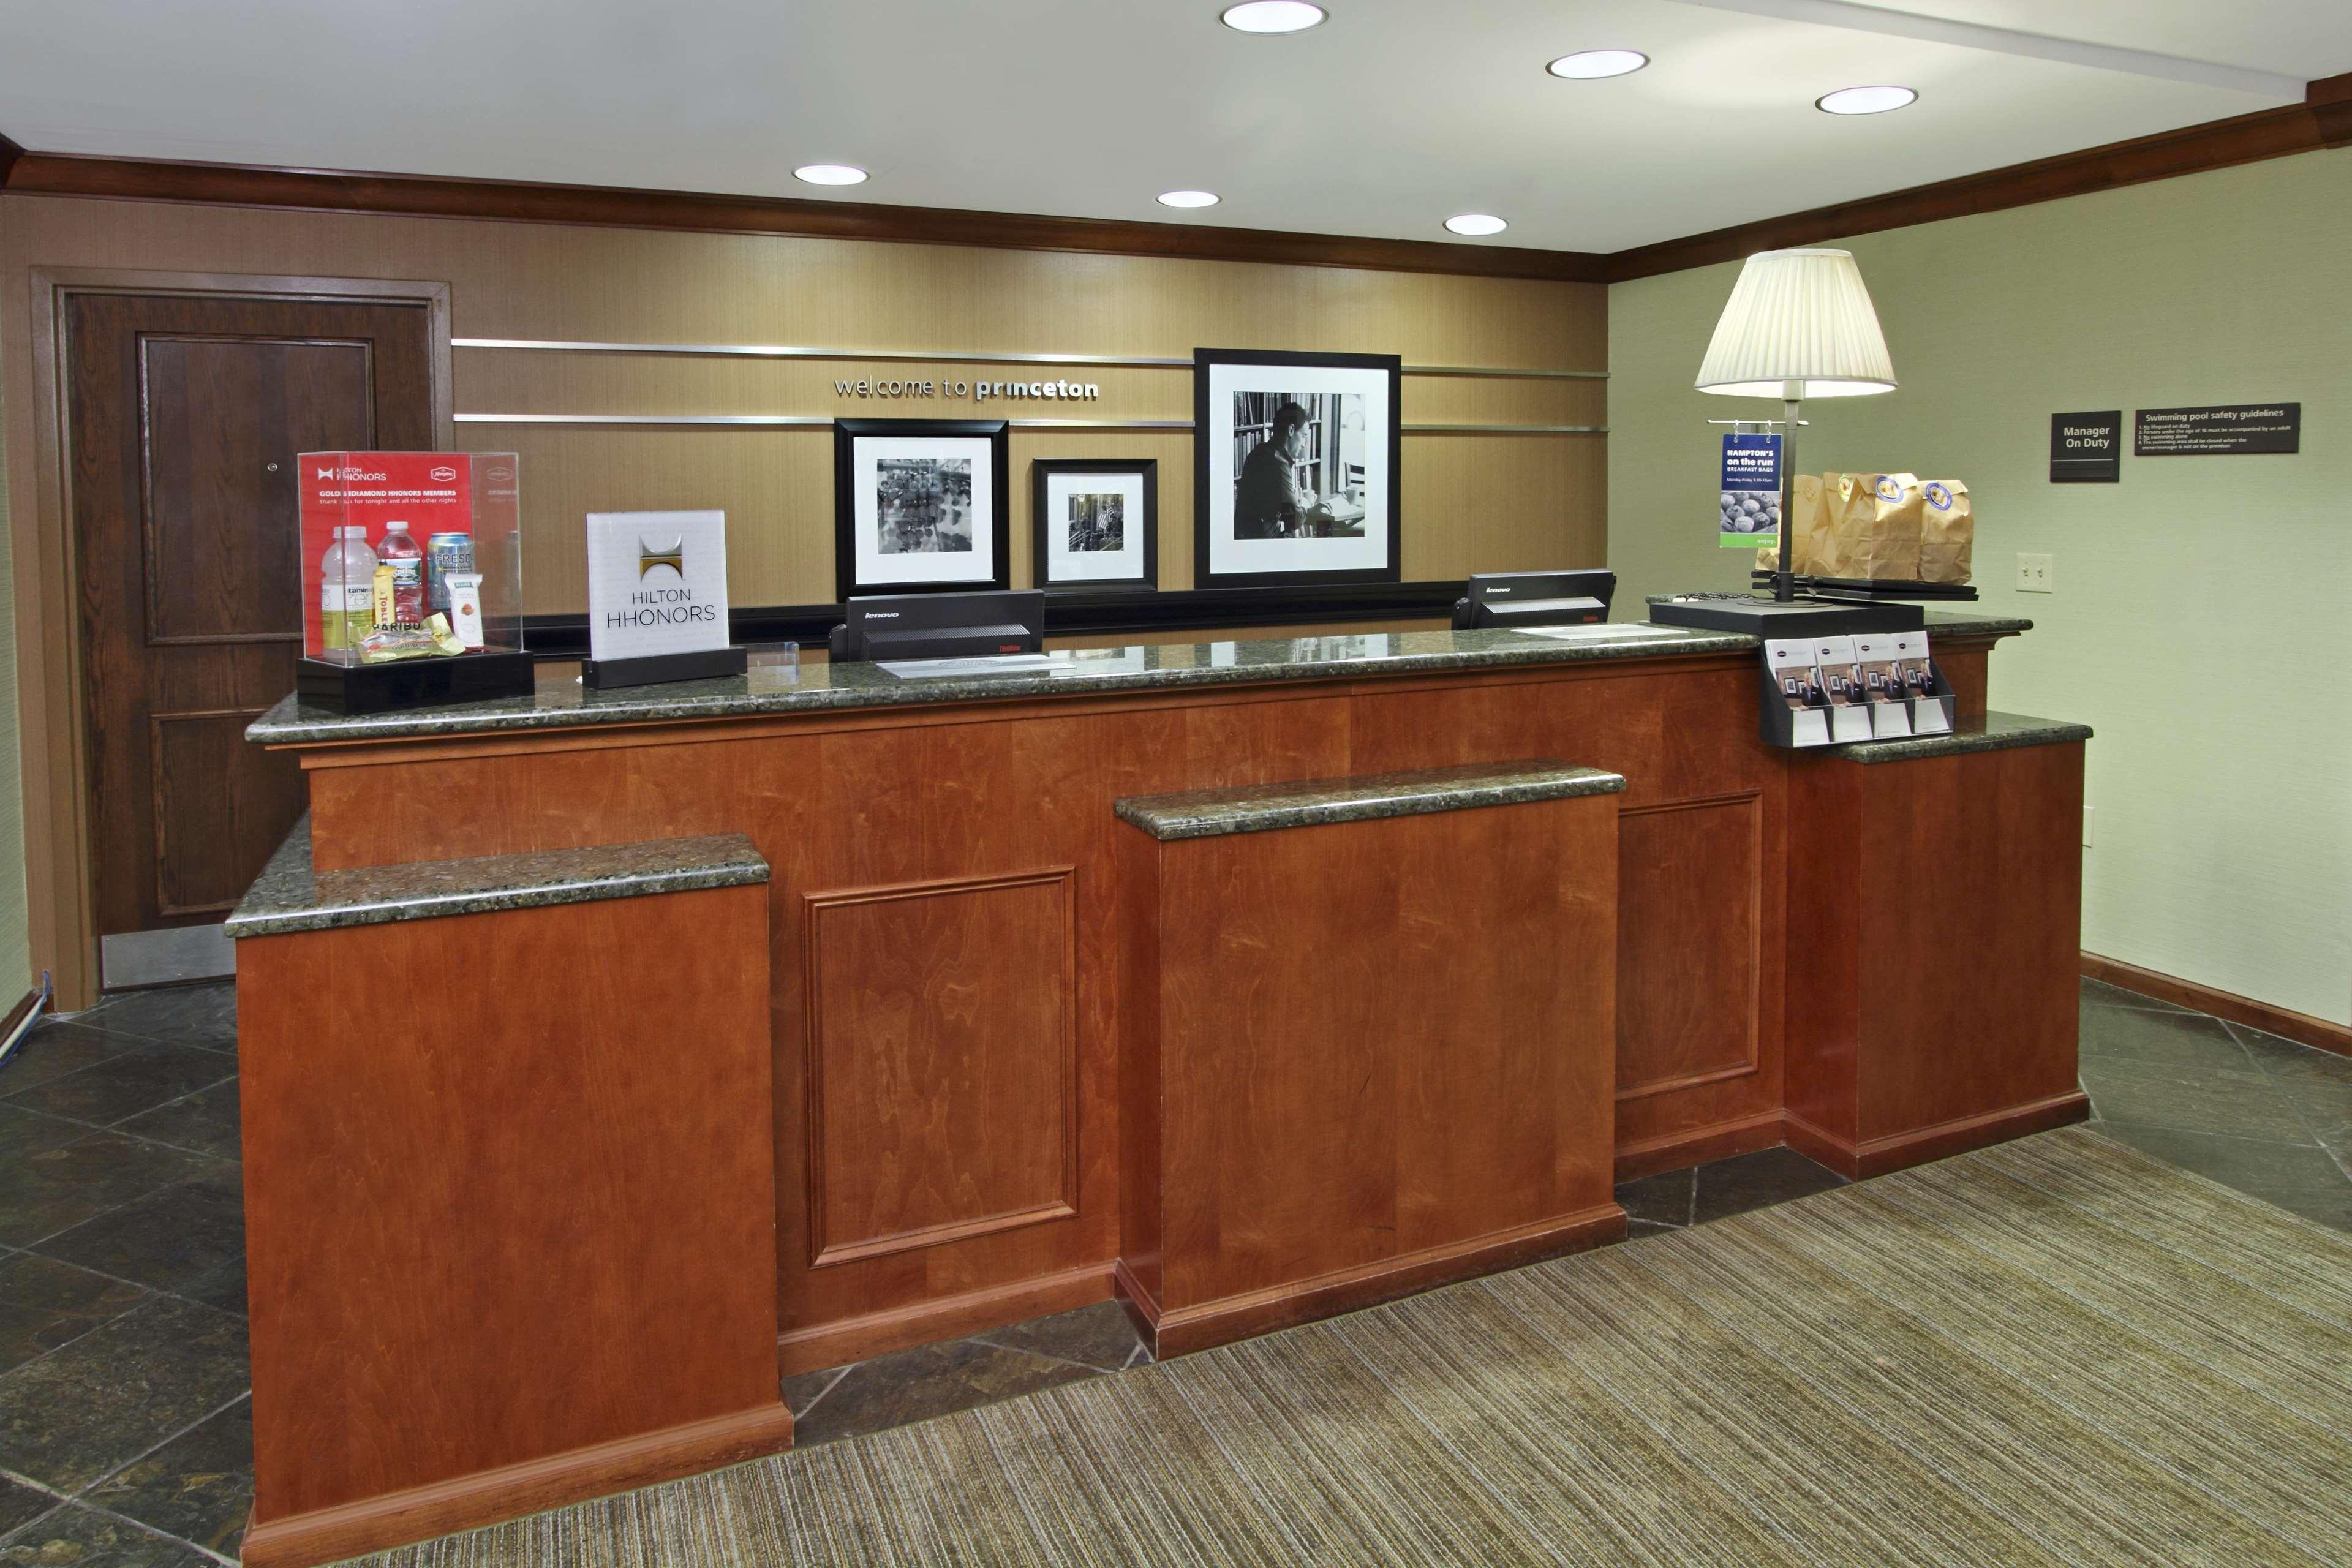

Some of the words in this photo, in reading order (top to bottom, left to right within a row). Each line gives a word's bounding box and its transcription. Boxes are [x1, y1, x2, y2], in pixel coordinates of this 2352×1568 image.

[835, 375, 933, 396] welcome
[943, 379, 967, 396] to
[976, 378, 1099, 400] princeton
[2146, 413, 2187, 422] Swimming
[2189, 412, 2209, 421] pool
[2211, 411, 2237, 420] safety
[2240, 409, 2284, 420] guidelines
[2064, 427, 2111, 437] Manager
[2065, 439, 2081, 448] On
[2084, 438, 2109, 449] Duty
[436, 553, 471, 564] FRESC
[347, 593, 373, 606] zer
[633, 588, 691, 604] HILTON
[379, 595, 388, 624] TOBLE
[607, 605, 715, 628] HHONORS
